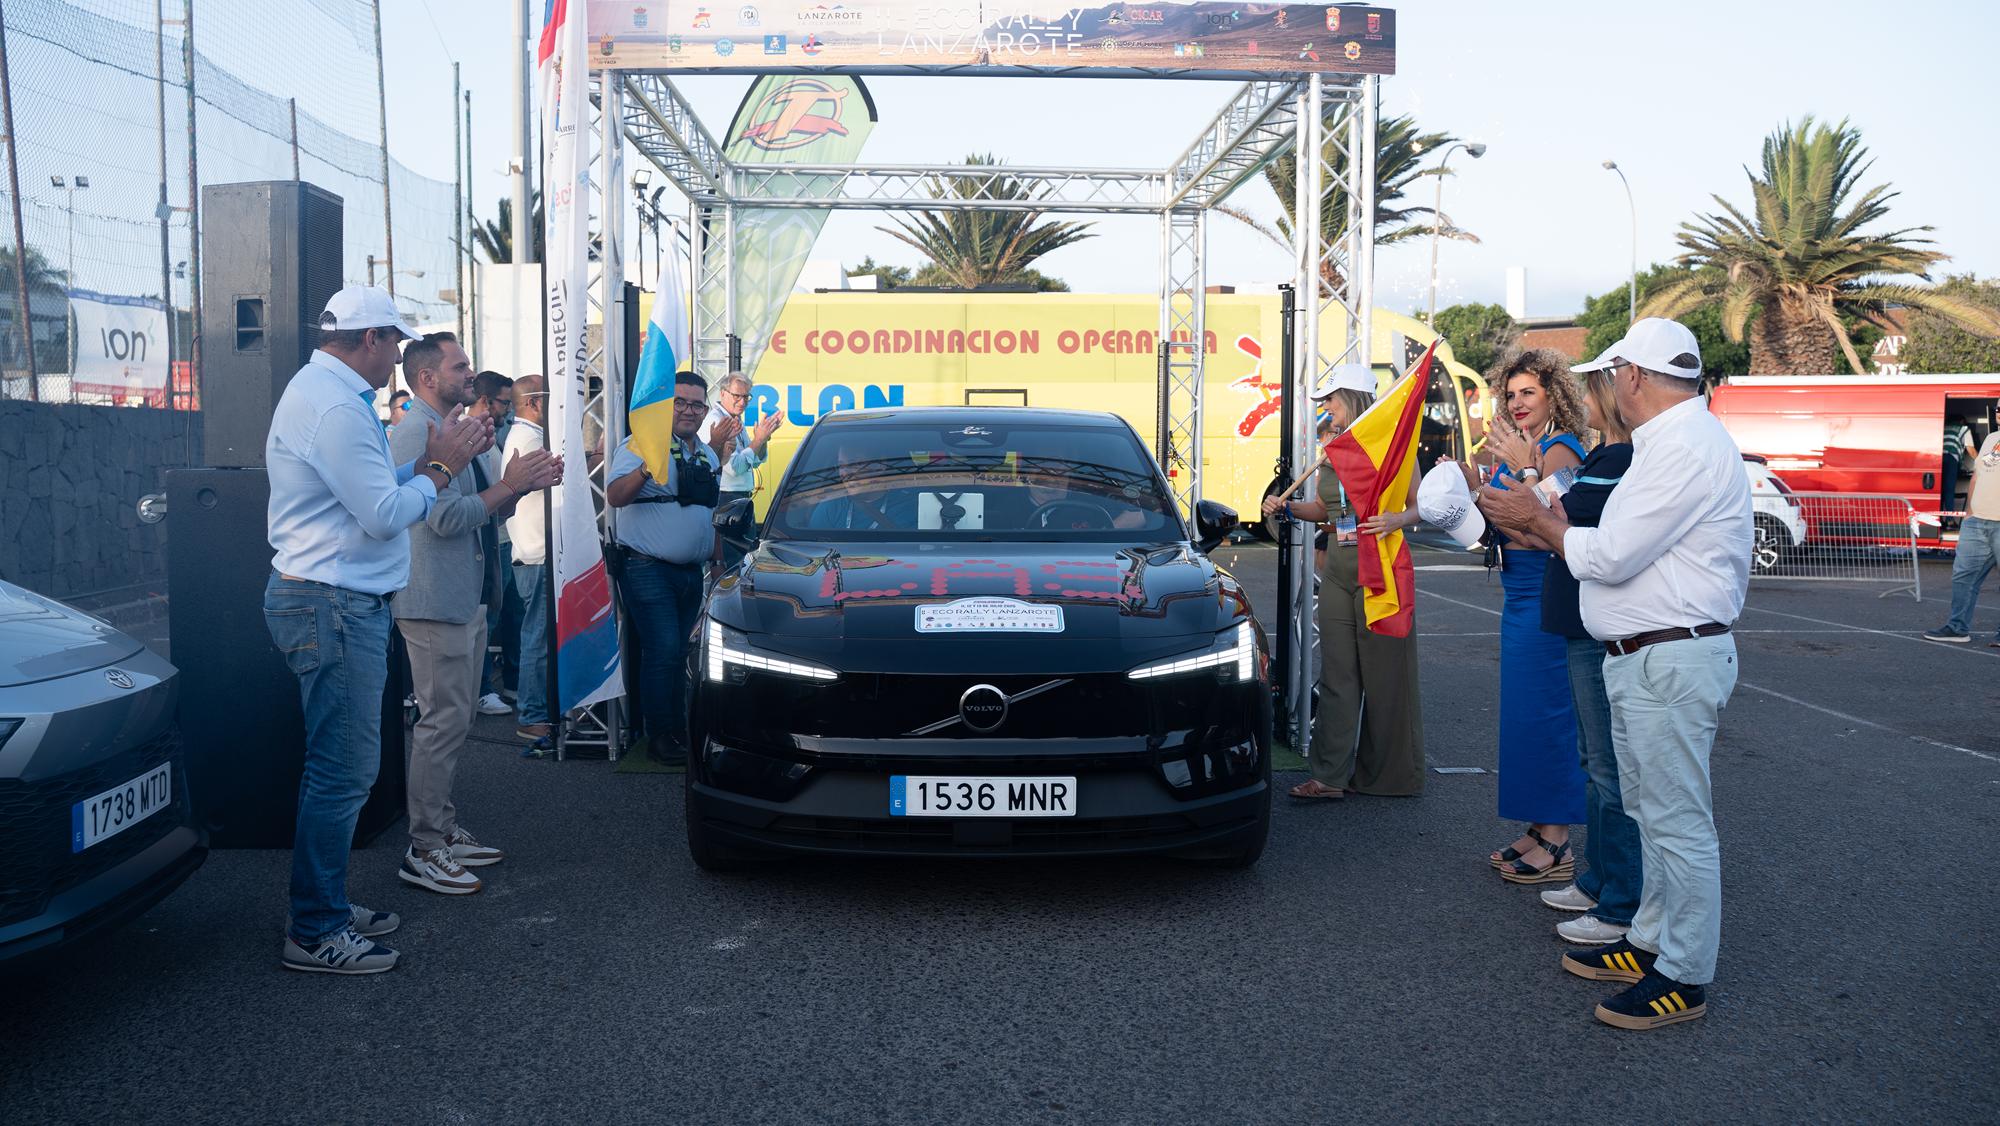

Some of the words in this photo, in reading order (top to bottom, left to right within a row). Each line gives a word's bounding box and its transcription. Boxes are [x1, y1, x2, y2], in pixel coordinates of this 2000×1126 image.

[797, 12, 863, 20] LANZAROTE
[914, 8, 976, 30] ECO
[988, 8, 1085, 31] RALLY
[1130, 9, 1164, 21] CICAR
[878, 33, 1084, 57] LANZAROTE
[804, 329, 1040, 354] COORDINACION
[1057, 329, 1218, 354] OPERAIVA
[91, 786, 135, 837] 1738
[140, 770, 167, 813] MTD
[894, 799, 902, 808] E
[918, 782, 995, 811] 1536
[1008, 783, 1068, 811] MNR
